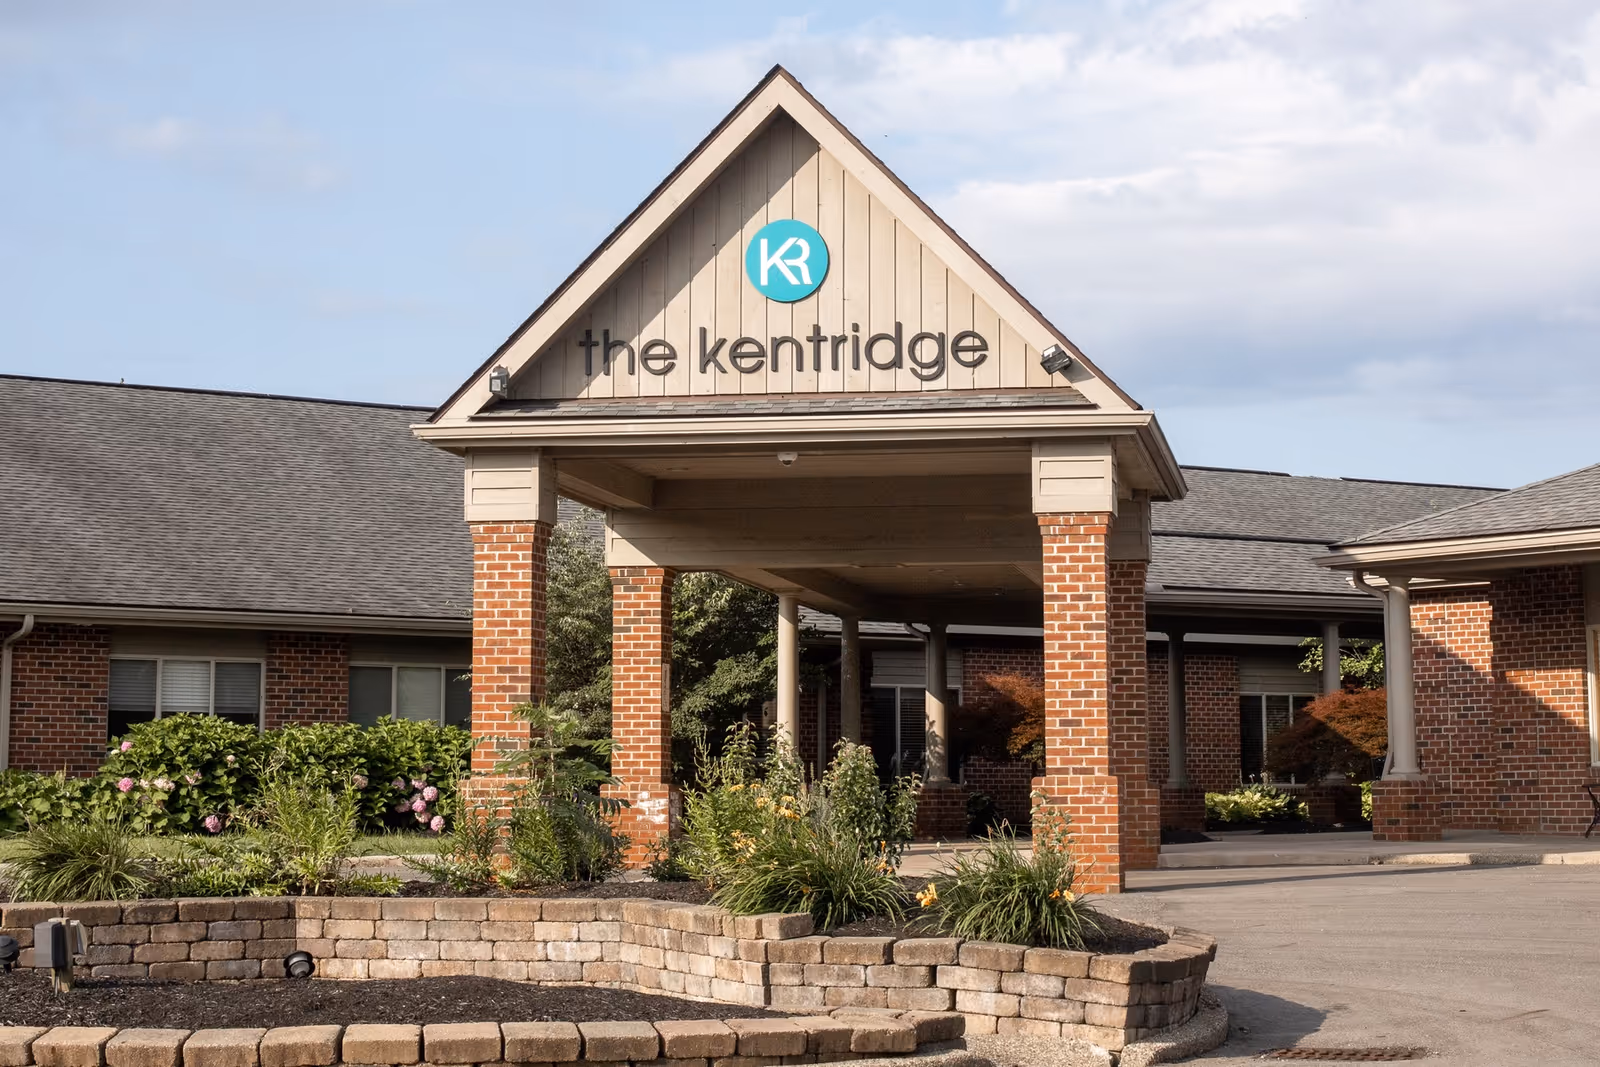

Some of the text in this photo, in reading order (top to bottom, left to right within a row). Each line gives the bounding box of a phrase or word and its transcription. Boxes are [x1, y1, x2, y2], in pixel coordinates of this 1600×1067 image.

[760, 237, 812, 285] KR
[579, 321, 988, 380] the kentridge
